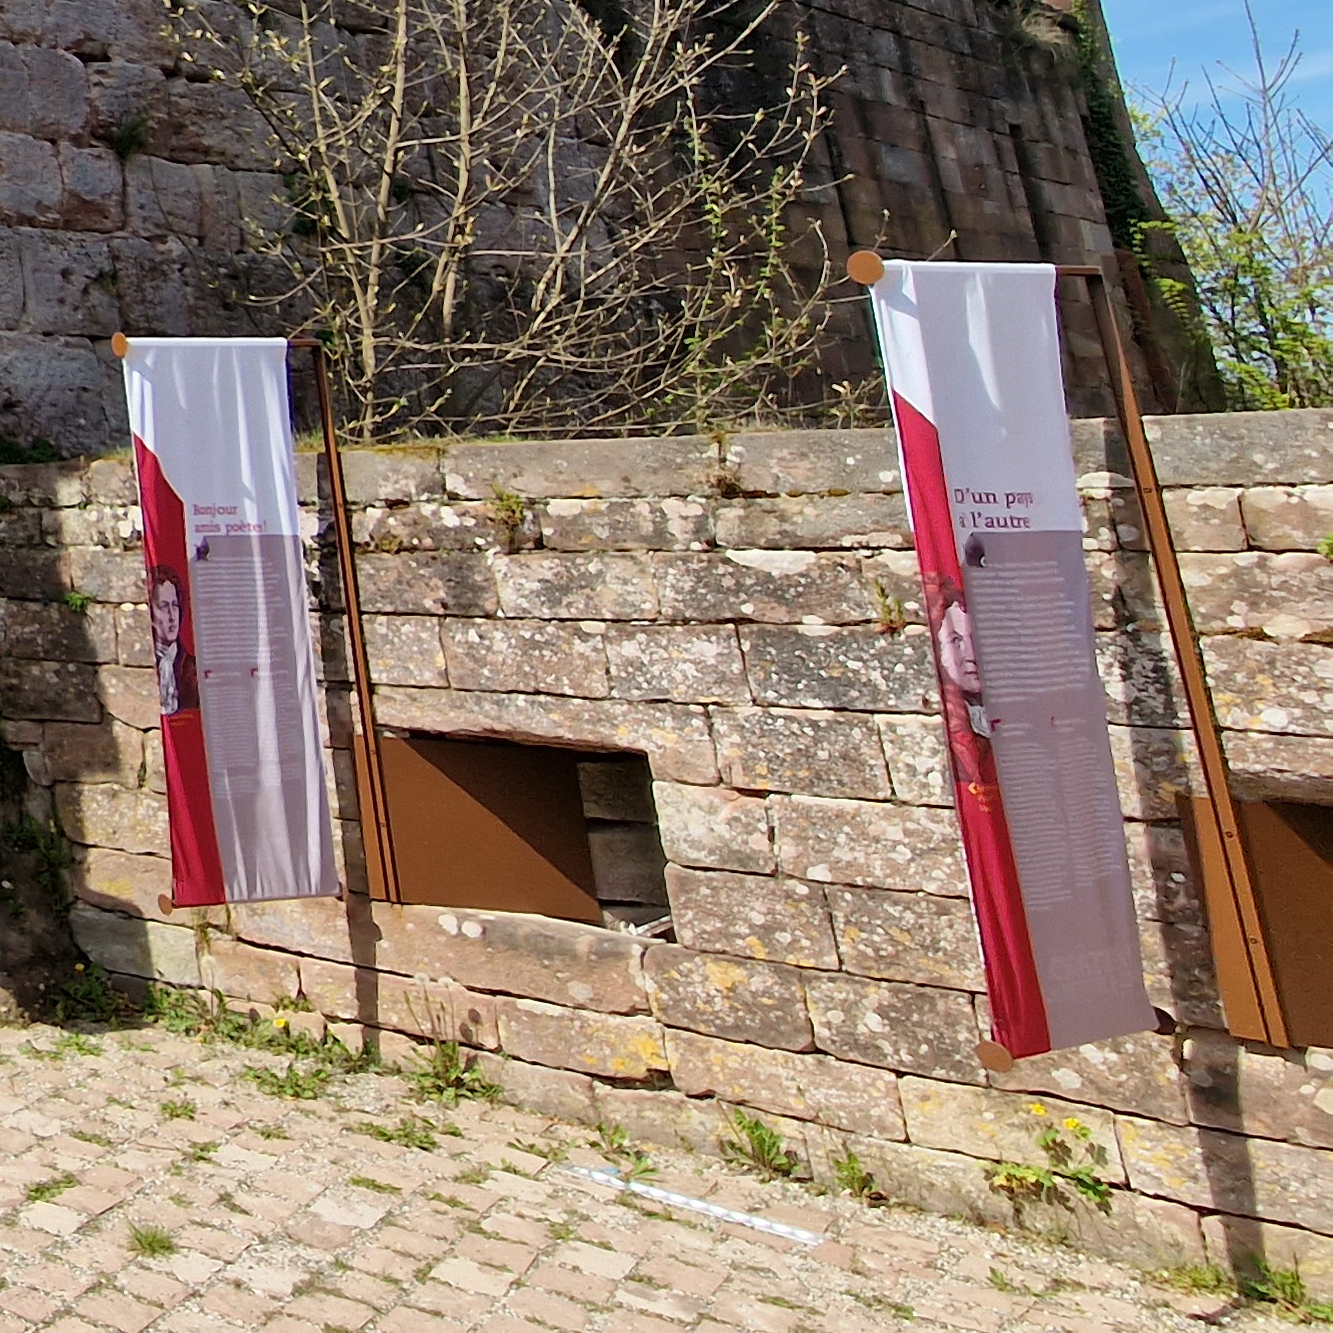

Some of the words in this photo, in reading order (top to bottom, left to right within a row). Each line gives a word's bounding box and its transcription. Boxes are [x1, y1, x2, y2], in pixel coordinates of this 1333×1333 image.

[954, 488, 999, 504] D'un
[1004, 492, 1034, 509] pays
[193, 503, 238, 518] Bonjour
[195, 520, 221, 533] amis
[970, 511, 1031, 528] l'autre
